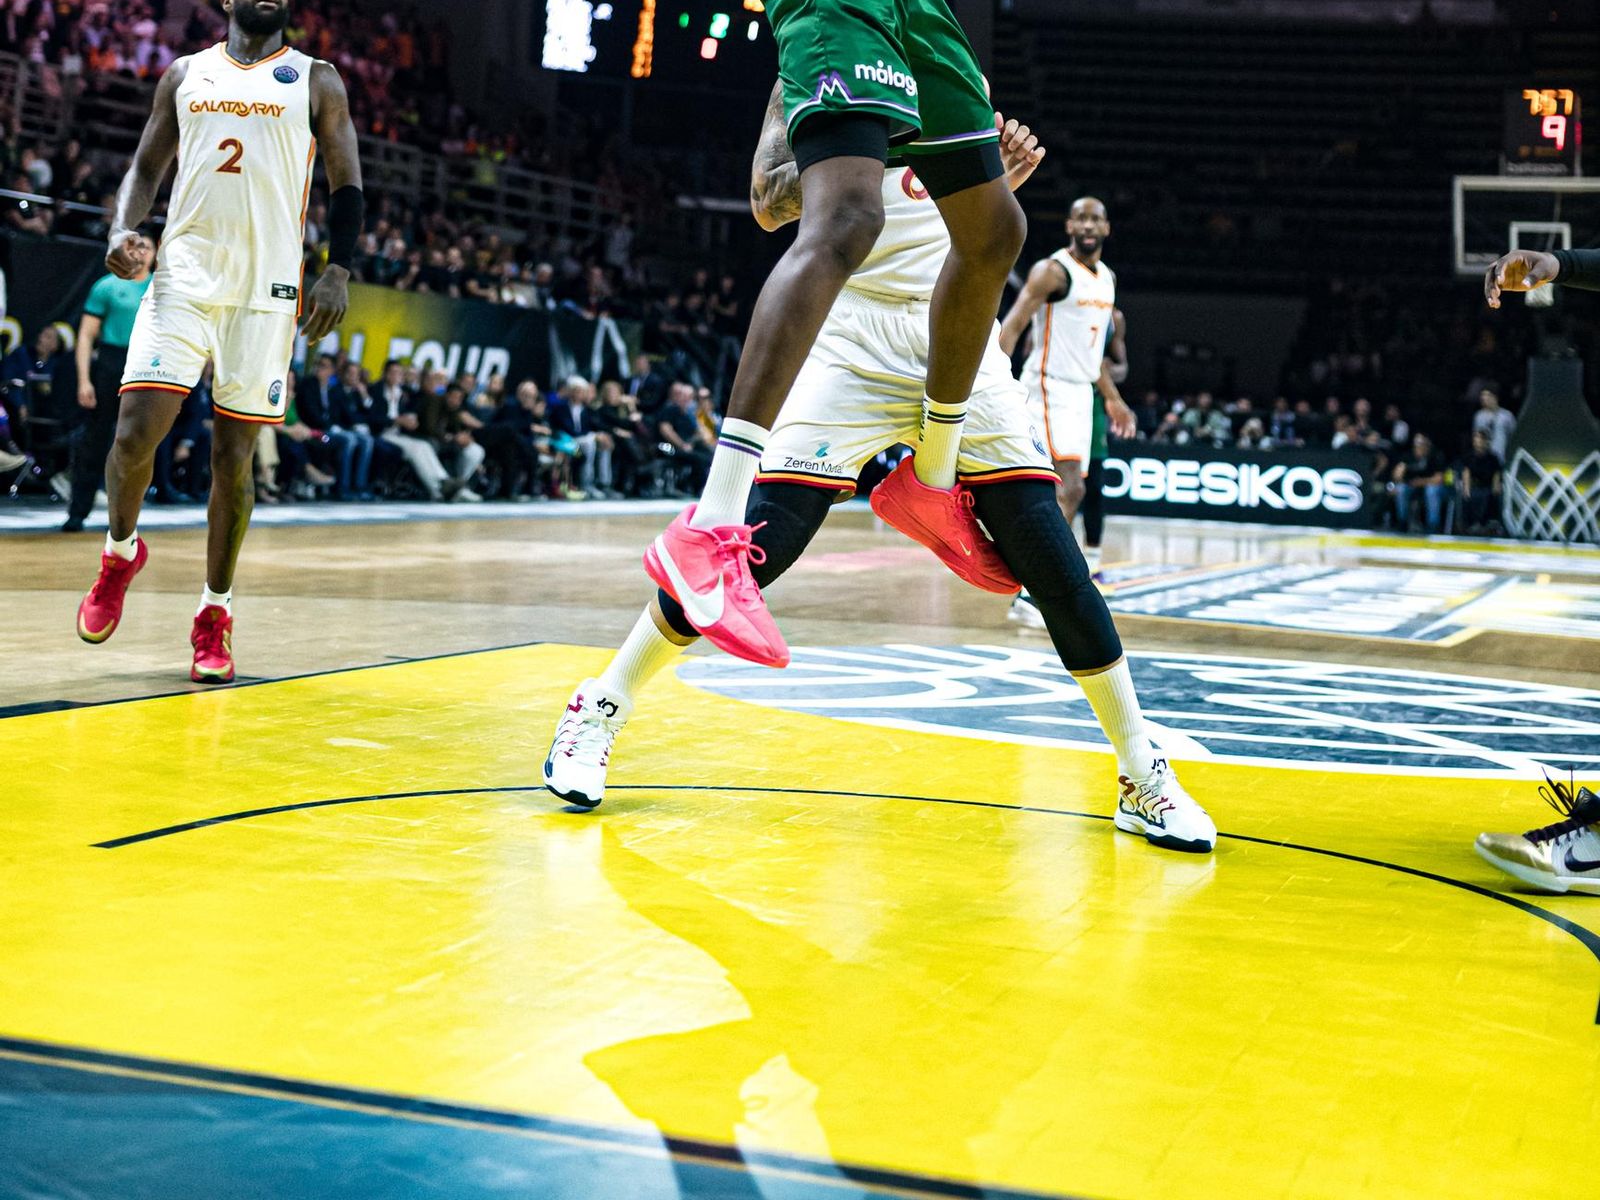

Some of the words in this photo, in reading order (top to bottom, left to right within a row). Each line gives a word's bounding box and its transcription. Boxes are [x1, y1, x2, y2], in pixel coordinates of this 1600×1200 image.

[189, 99, 286, 118] GALATASARAY
[1541, 115, 1567, 151] 9
[215, 137, 244, 174] 2
[784, 456, 819, 471] Zeren
